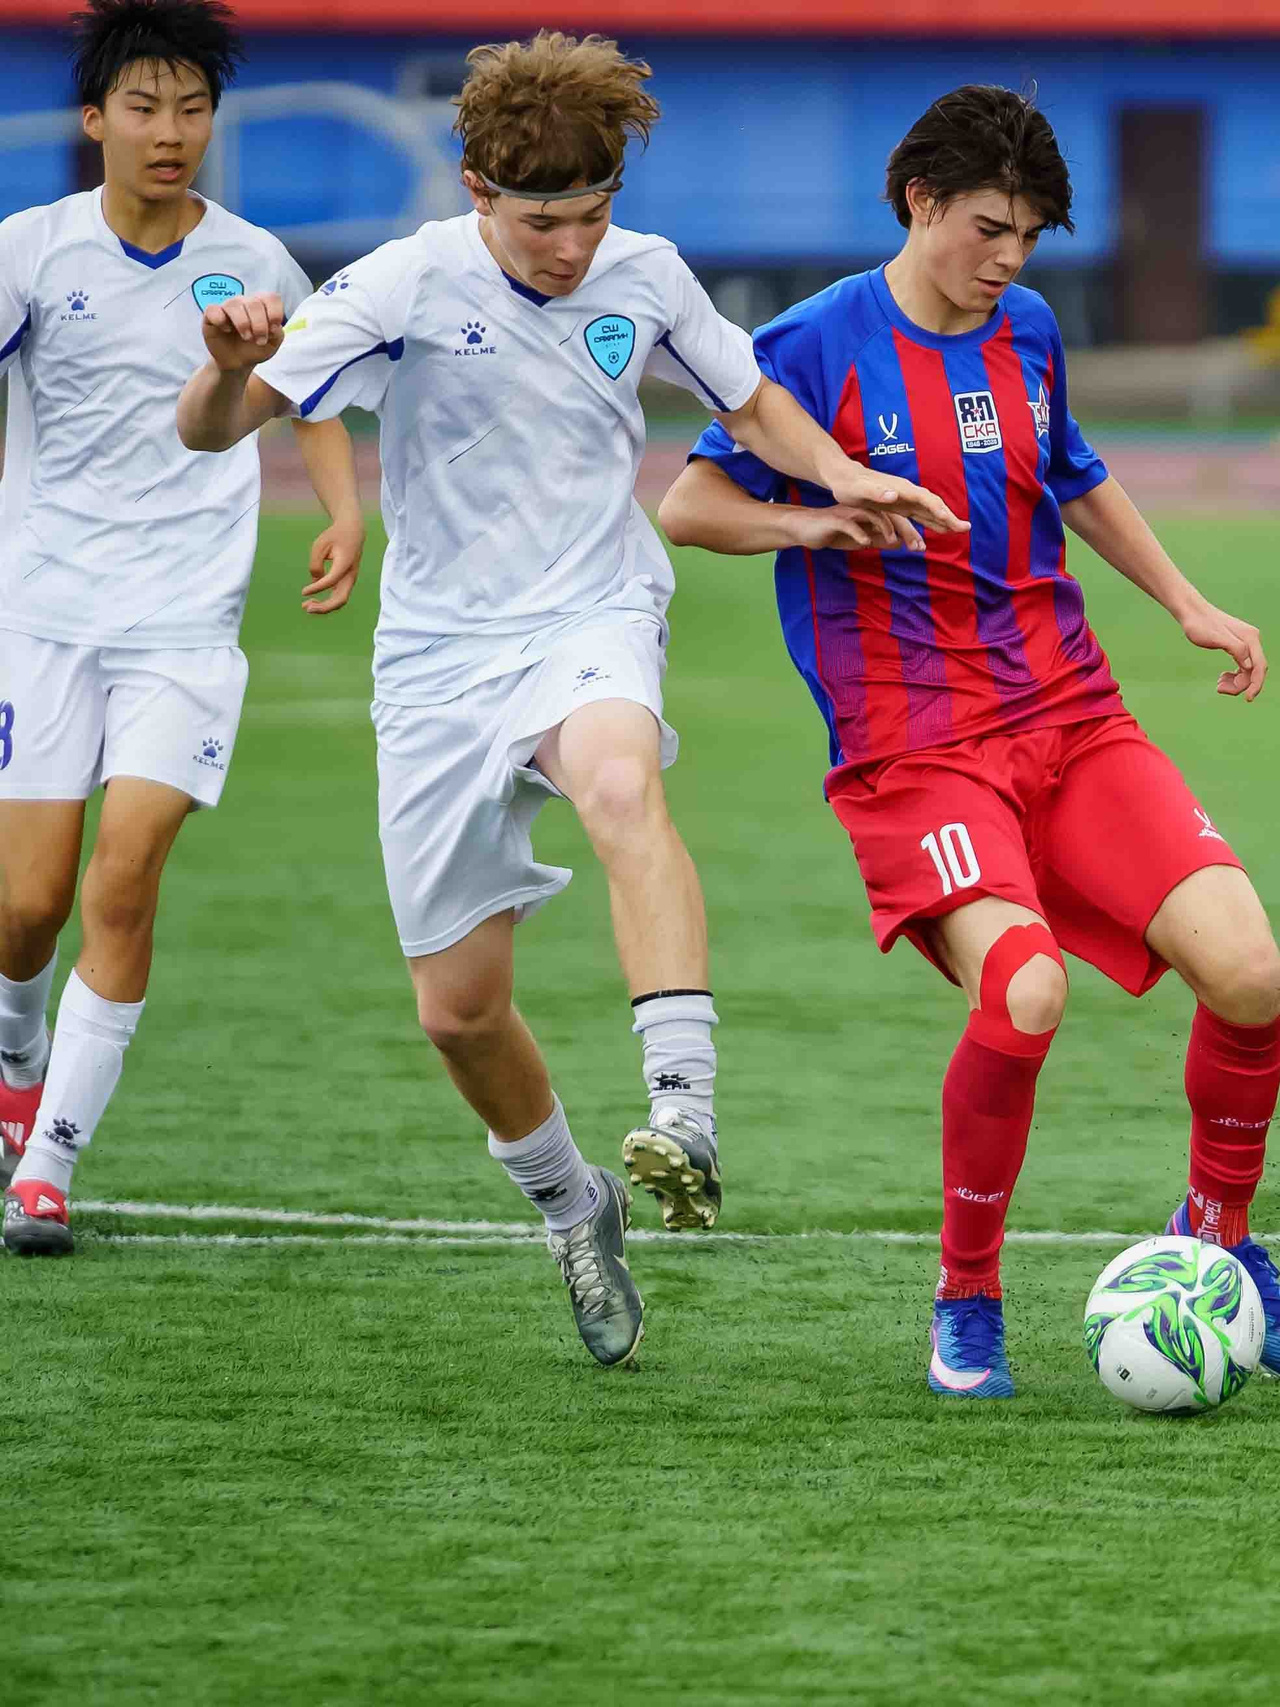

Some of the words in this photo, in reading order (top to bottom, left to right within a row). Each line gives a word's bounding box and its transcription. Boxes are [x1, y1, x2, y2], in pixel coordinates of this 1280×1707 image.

[60, 313, 98, 321] KELME
[454, 346, 497, 356] KELME
[868, 442, 916, 456] JÖGEL
[920, 822, 982, 897] 10
